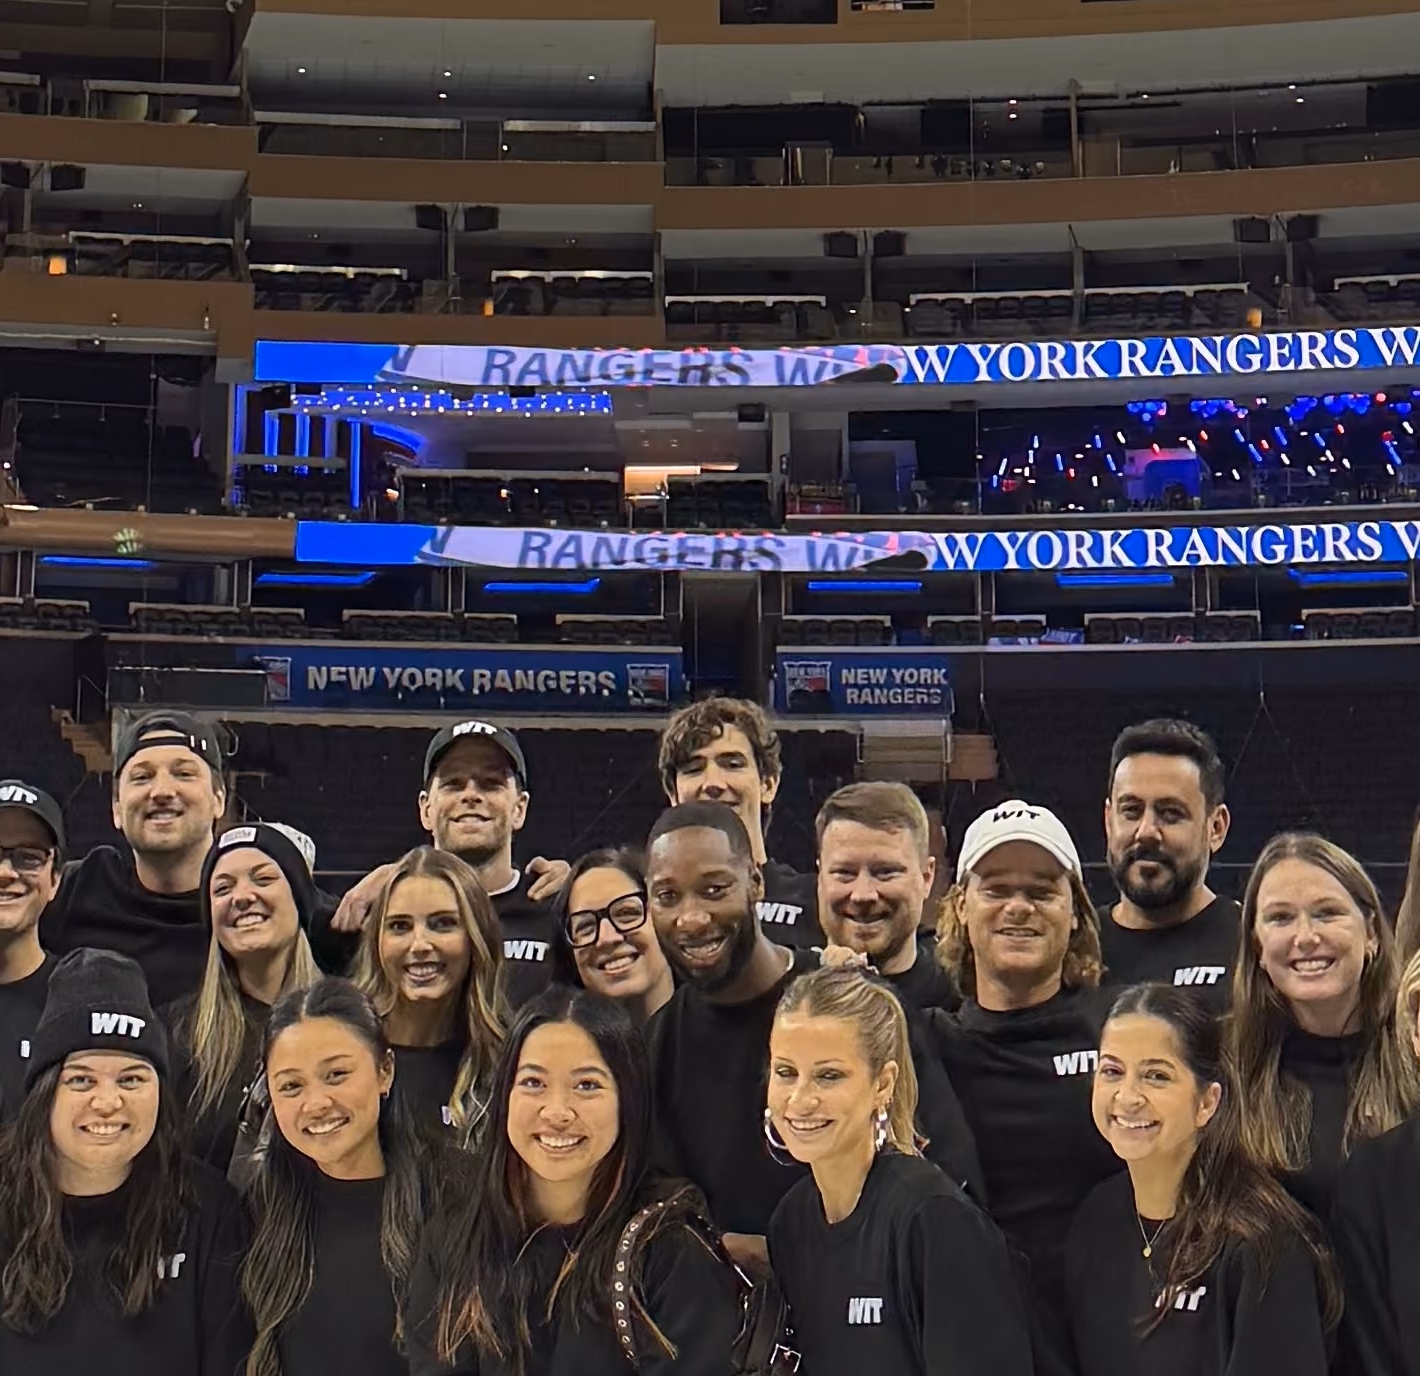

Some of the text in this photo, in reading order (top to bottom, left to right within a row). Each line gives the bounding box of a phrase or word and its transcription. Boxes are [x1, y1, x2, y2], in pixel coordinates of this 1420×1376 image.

[481, 348, 753, 387] RANGERS
[965, 341, 1111, 382] YORK
[1116, 329, 1360, 377] RANGERS
[517, 530, 786, 571] RANGERS
[994, 529, 1136, 570] YORK
[1143, 523, 1383, 567] RANGERS
[307, 665, 617, 695] NEW YORK RANGERS
[841, 668, 889, 685] NEW
[891, 668, 949, 685] YORK
[846, 687, 942, 704] RANGERS
[453, 721, 497, 737] WIT
[992, 809, 1041, 823] WIT
[755, 902, 803, 925] WIT
[504, 940, 549, 961] WIT
[1174, 966, 1226, 986] WIT
[92, 1012, 145, 1038] WIT
[849, 1297, 883, 1324] WIT
[1155, 1286, 1207, 1311] IT
